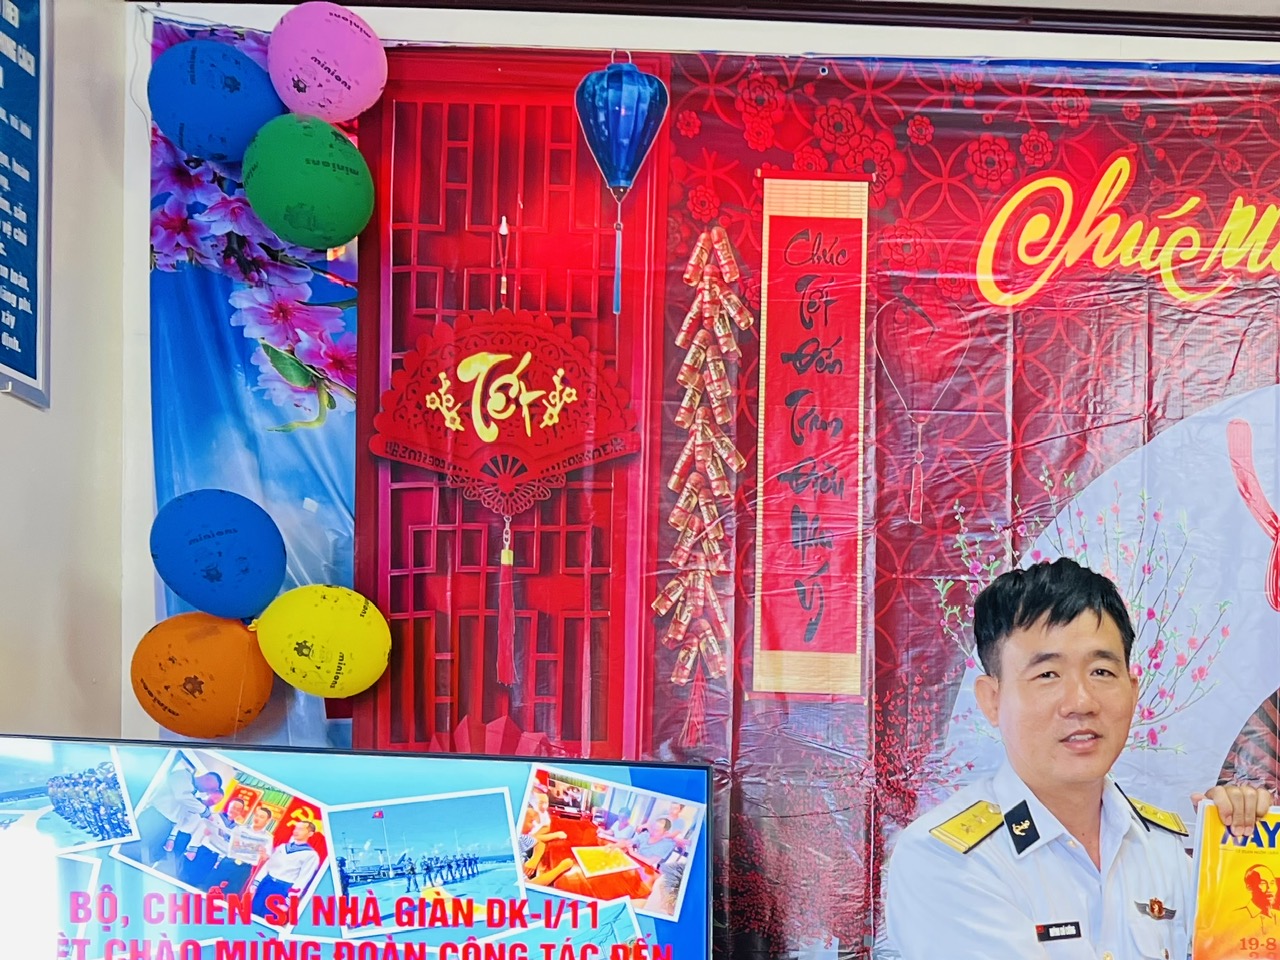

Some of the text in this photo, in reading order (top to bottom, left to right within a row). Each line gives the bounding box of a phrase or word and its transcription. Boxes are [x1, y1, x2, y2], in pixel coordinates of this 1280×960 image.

[310, 56, 351, 91] minions
[784, 229, 850, 266] Chúc
[974, 156, 1232, 307] Chúc
[457, 351, 547, 442] Tết
[330, 652, 345, 690] minions
[143, 881, 250, 925] CHIẾN
[265, 887, 301, 926] SĨ
[312, 888, 382, 928] NHÀ
[395, 890, 474, 928] GIÀN
[1240, 937, 1277, 951] 19-8
